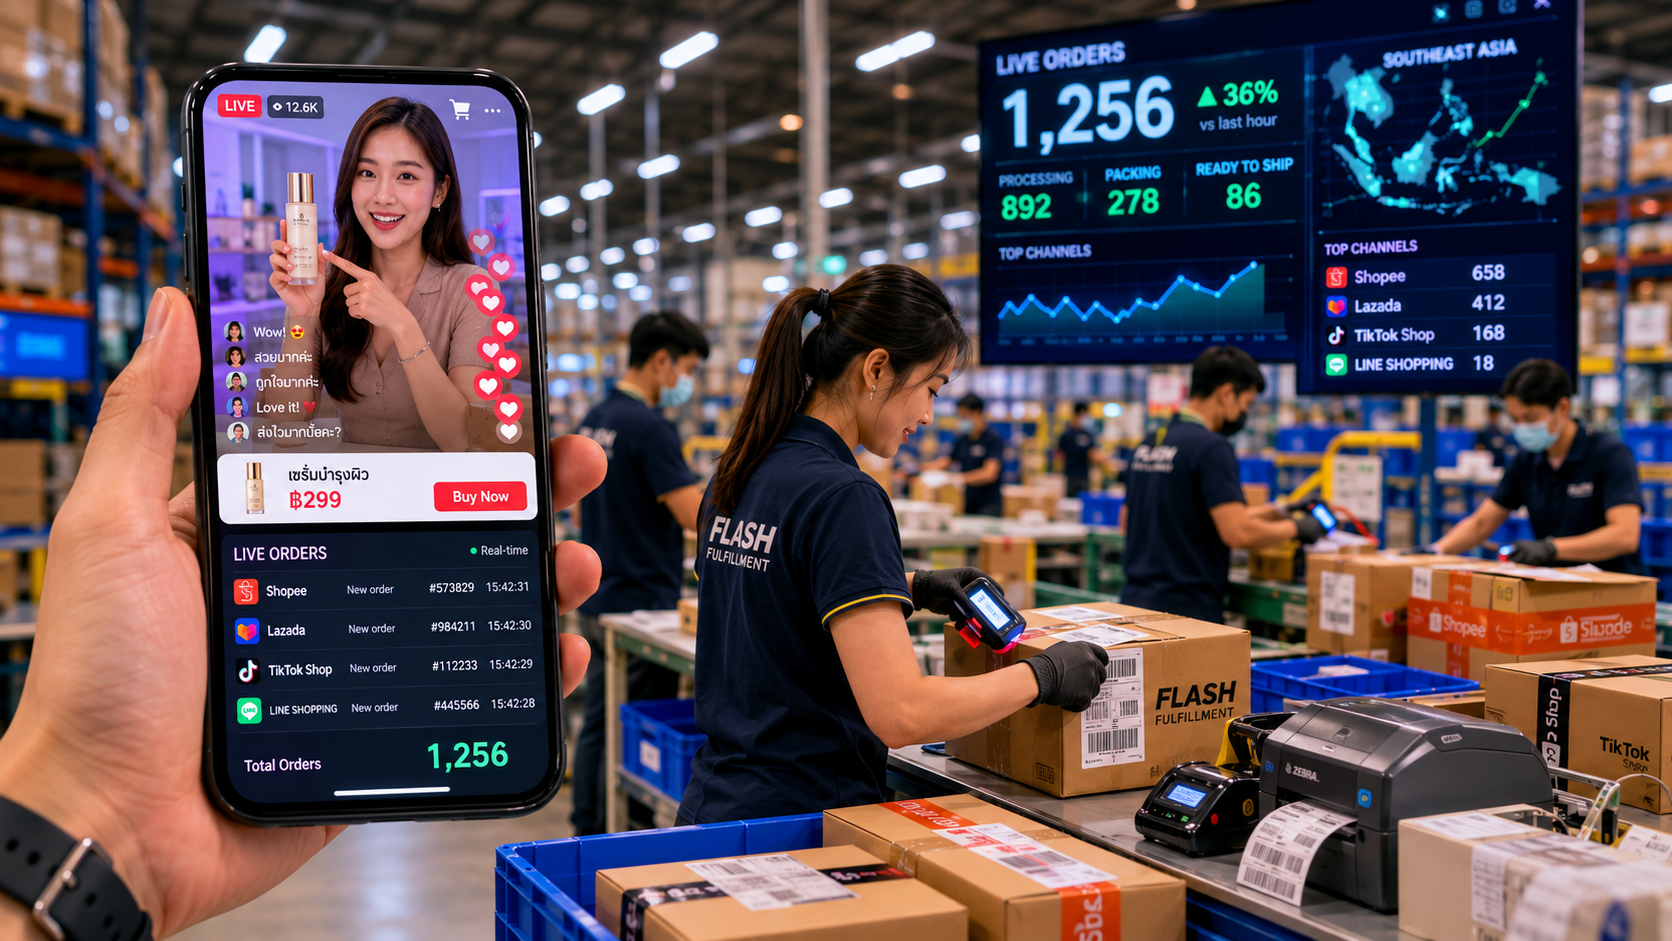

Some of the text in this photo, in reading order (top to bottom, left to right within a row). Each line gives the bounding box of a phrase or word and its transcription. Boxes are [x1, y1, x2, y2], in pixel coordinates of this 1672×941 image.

[996, 41, 1126, 76] LIVE ORDERS
[1383, 38, 1518, 68] SOUTHEAST ASIA
[1223, 79, 1279, 107] 36%
[225, 100, 255, 112] LIVE
[286, 101, 319, 113] 12.6K
[1002, 75, 1175, 155] 1,256
[1199, 114, 1278, 131] vs last hour
[1105, 165, 1162, 182] PACKING
[1196, 157, 1294, 177] READY TO SHIP
[999, 171, 1074, 188] PROCESSING
[1107, 188, 1160, 216] 278
[1226, 182, 1262, 210] 86
[1001, 193, 1052, 221] 892
[999, 244, 1092, 261] TOP CHANNELS
[1325, 239, 1418, 256] TOP CHANNELS
[1354, 270, 1406, 286] Shopee
[1472, 264, 1506, 281] 658
[1354, 299, 1402, 314] Lazada
[1472, 294, 1506, 311] 412
[253, 326, 286, 338] Wow!
[1354, 327, 1435, 344] TikTok Shop
[1472, 325, 1506, 341] 168
[1354, 357, 1454, 372] LINE SHOPPING
[1473, 355, 1495, 371] 18
[256, 401, 300, 413] Love it!
[289, 489, 342, 511] ฿299
[452, 489, 510, 504] Buy Now
[708, 515, 778, 554] FLASH
[233, 545, 328, 562] LIVE ORDERS
[480, 545, 529, 557] Real-time
[706, 547, 771, 572] FULFILLMENT
[266, 584, 308, 599] Shopee
[347, 584, 395, 595] New order
[428, 582, 475, 595] #573829
[485, 581, 530, 593] 15:42:31
[267, 623, 306, 637] Lazada
[348, 623, 396, 634] New order
[430, 621, 476, 632] #984211
[487, 619, 532, 631] 15:42:30
[1442, 614, 1486, 638] Shopee
[268, 663, 333, 678] TikTok Shop
[349, 662, 397, 673] New order
[432, 659, 478, 672] #112233
[489, 658, 534, 670] 15:42:29
[1155, 680, 1237, 710] FLASH
[269, 703, 338, 716] LINE SHOPPING
[351, 702, 399, 713] New order
[433, 699, 481, 711] #445566
[490, 698, 536, 710] 15:42:28
[1155, 707, 1235, 726] FULFILLMENT
[427, 740, 509, 774] 1,256
[1599, 736, 1650, 762] TikTok
[243, 757, 322, 773] Total Orders
